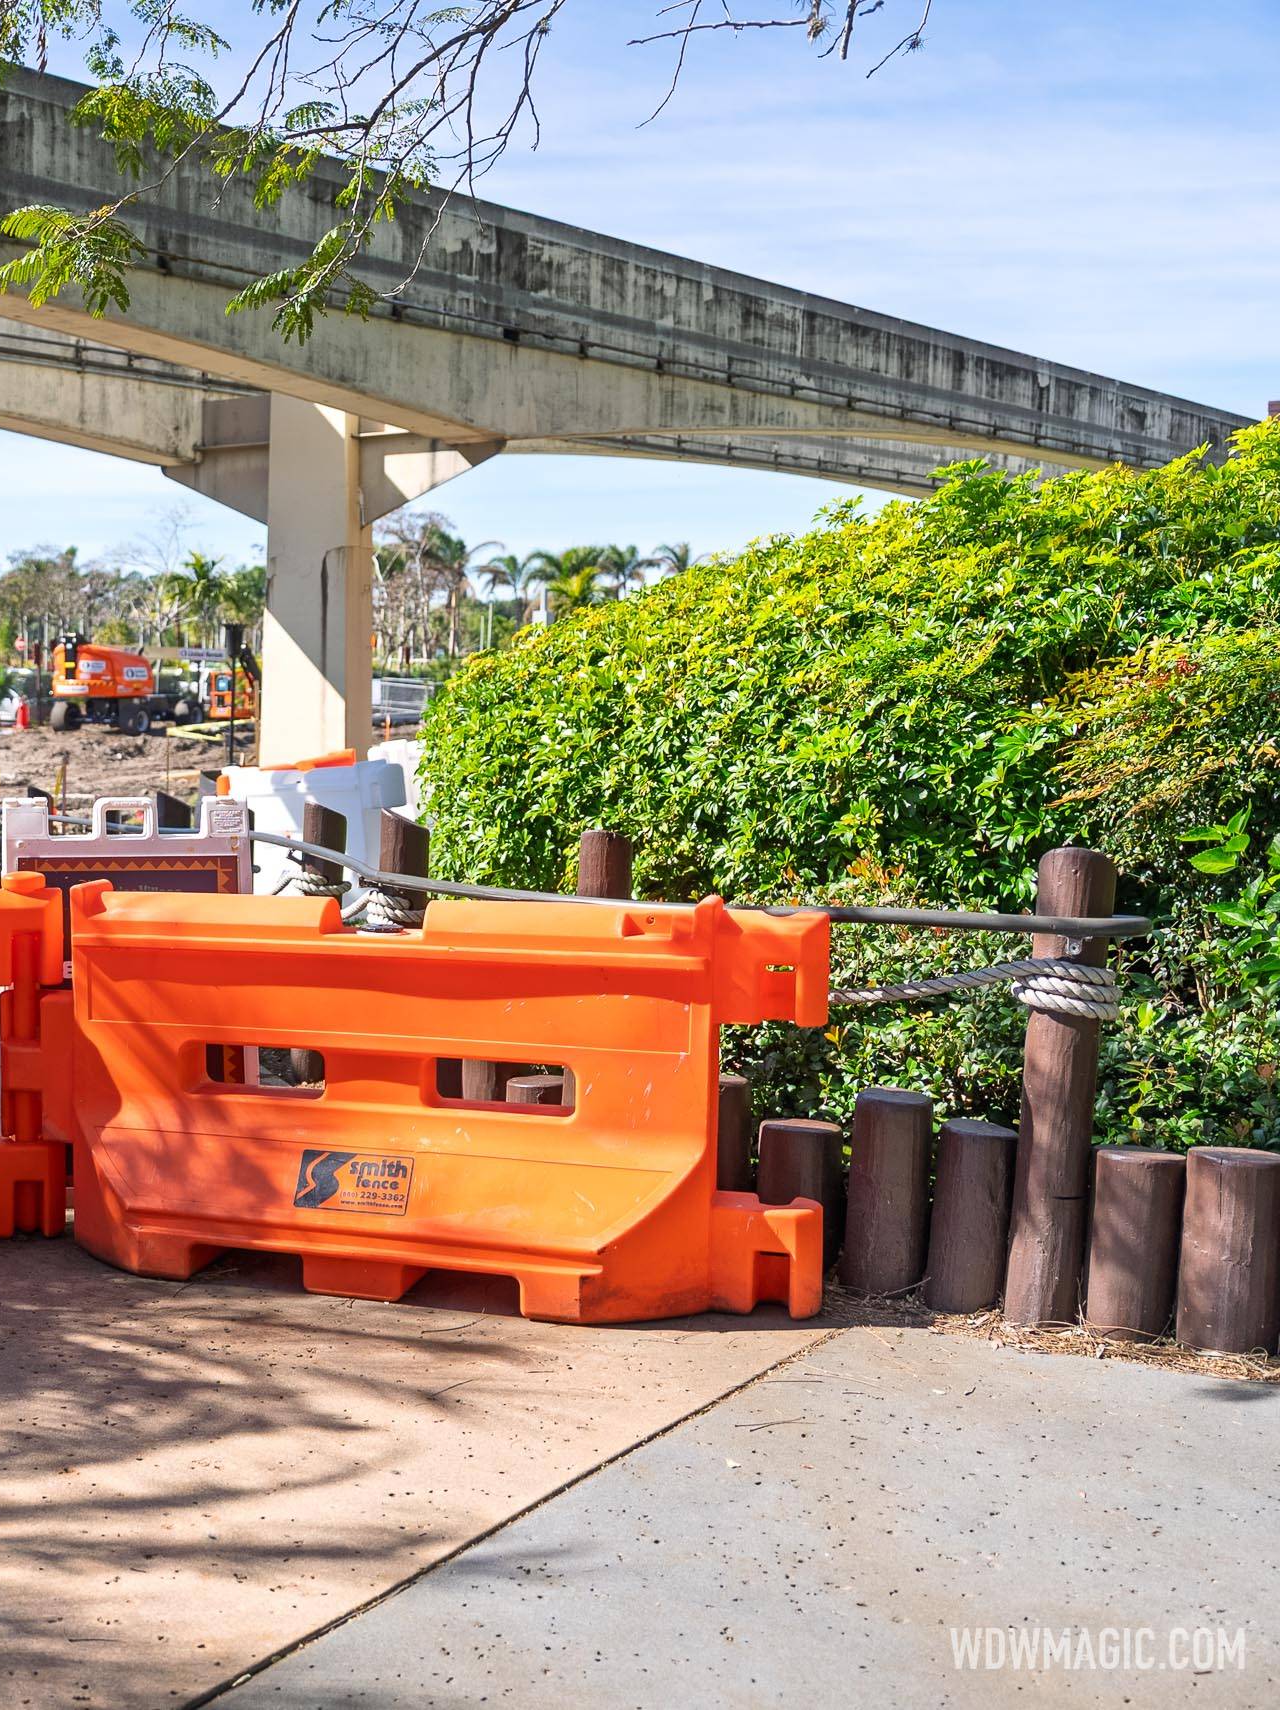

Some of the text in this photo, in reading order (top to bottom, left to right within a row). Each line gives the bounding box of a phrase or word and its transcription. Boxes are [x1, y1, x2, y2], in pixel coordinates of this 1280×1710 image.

[350, 1159, 407, 1178] smith
[356, 1175, 399, 1190] fence
[360, 1191, 405, 1201] 229-3362
